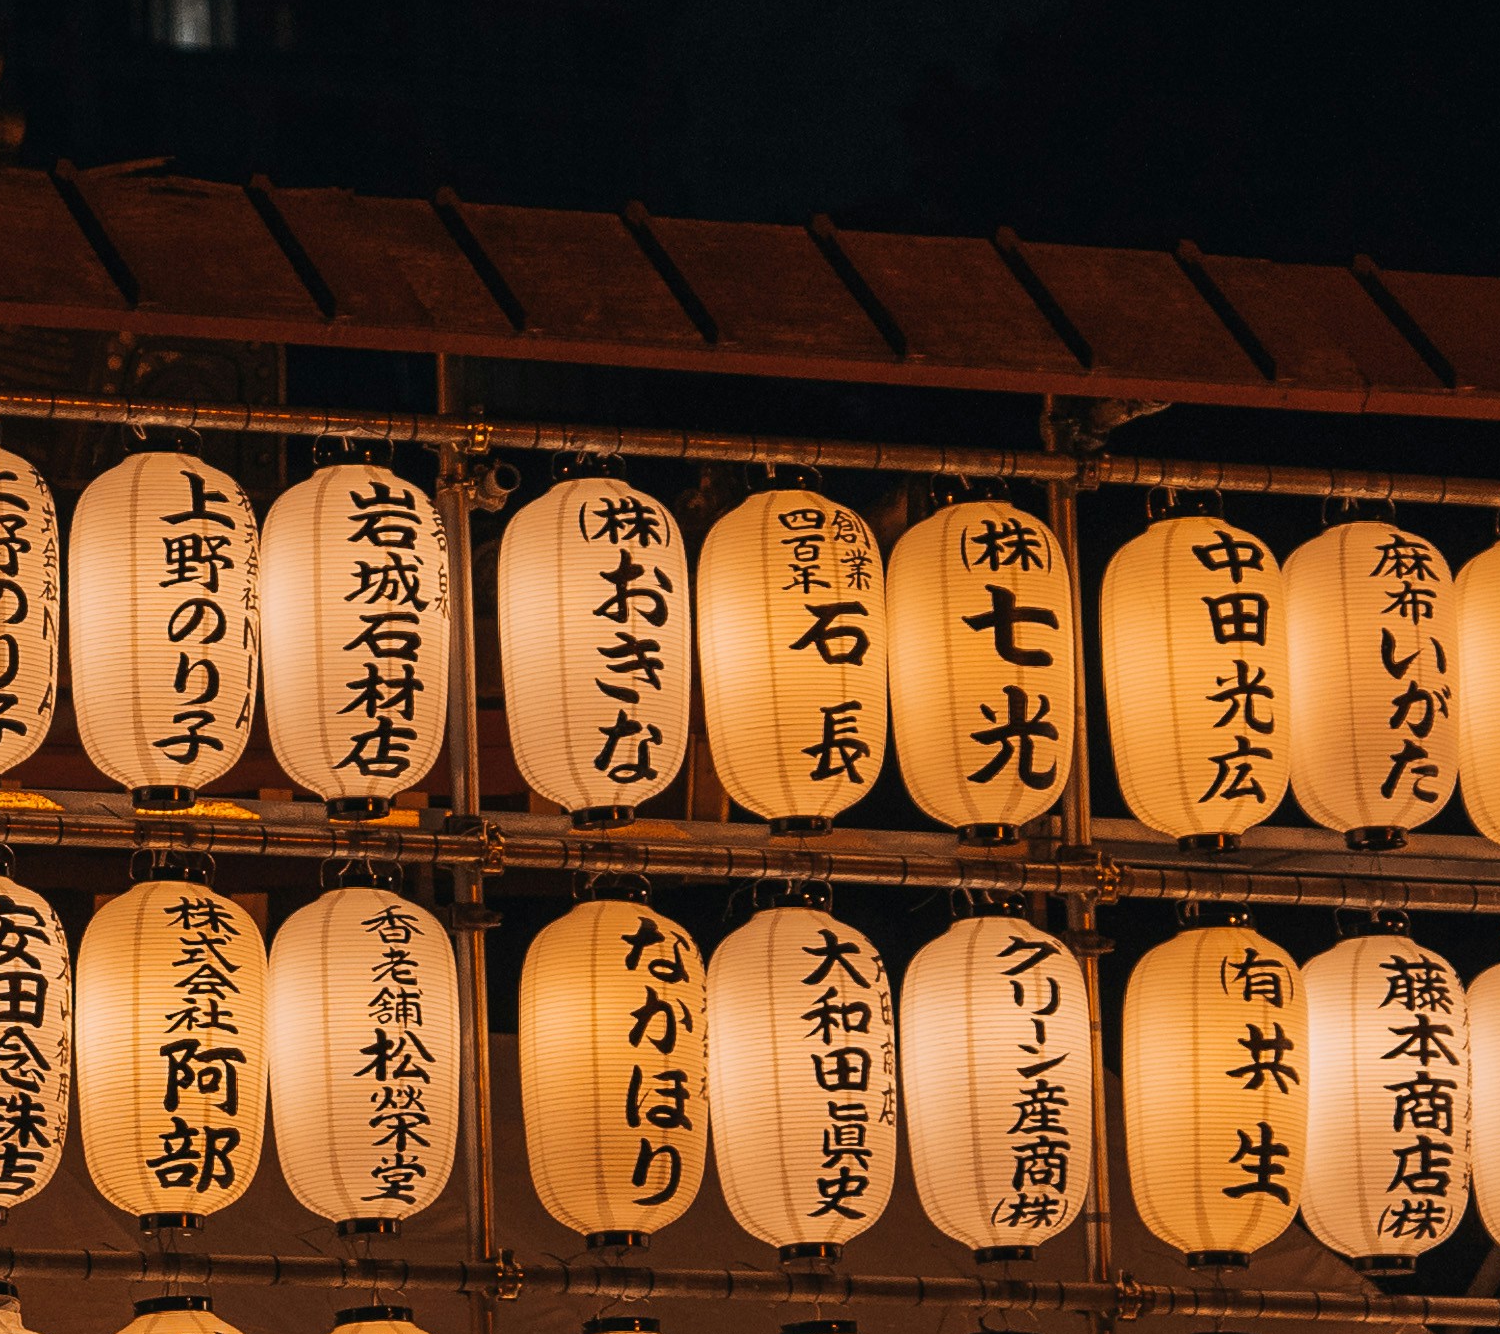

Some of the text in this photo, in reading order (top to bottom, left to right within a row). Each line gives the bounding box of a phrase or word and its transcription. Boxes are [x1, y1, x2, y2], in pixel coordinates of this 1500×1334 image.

[153, 469, 236, 765] 上野のり子
[333, 481, 430, 778] 岩城石材店
[777, 508, 831, 594] 四百年
[831, 510, 872, 591] 創業
[1192, 530, 1275, 804] 中田光広
[1369, 534, 1450, 804] 麻布いがた
[789, 600, 871, 784] 石長
[145, 896, 248, 1194] 株式会社阿部
[620, 916, 694, 1208] なかほり
